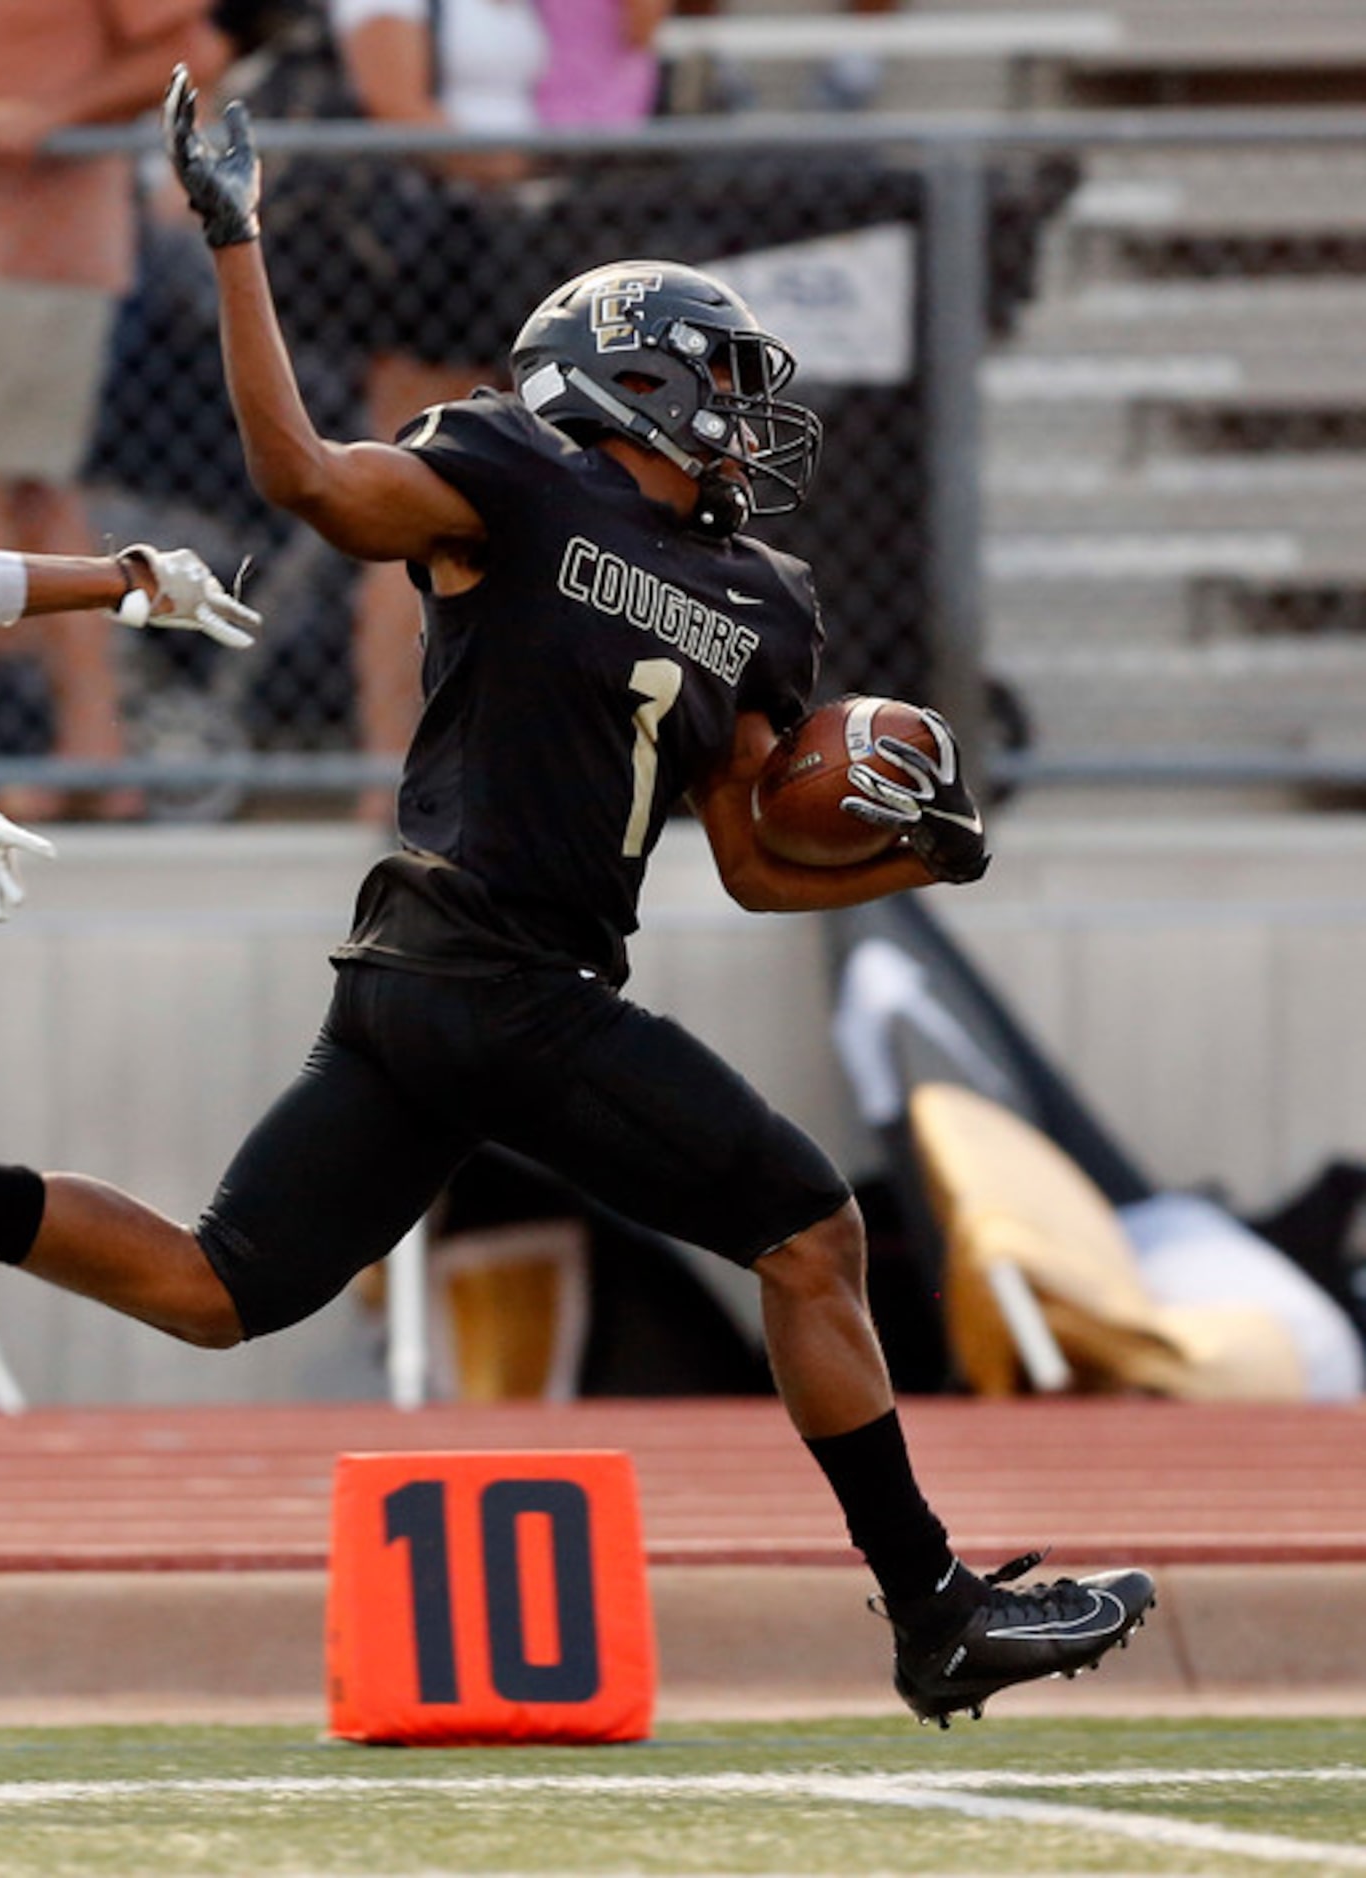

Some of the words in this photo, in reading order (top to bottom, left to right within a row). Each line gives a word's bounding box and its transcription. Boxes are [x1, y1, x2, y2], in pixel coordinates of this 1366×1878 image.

[557, 535, 760, 687] COUGARS
[622, 657, 683, 858] 1
[383, 1479, 602, 1705] 10
